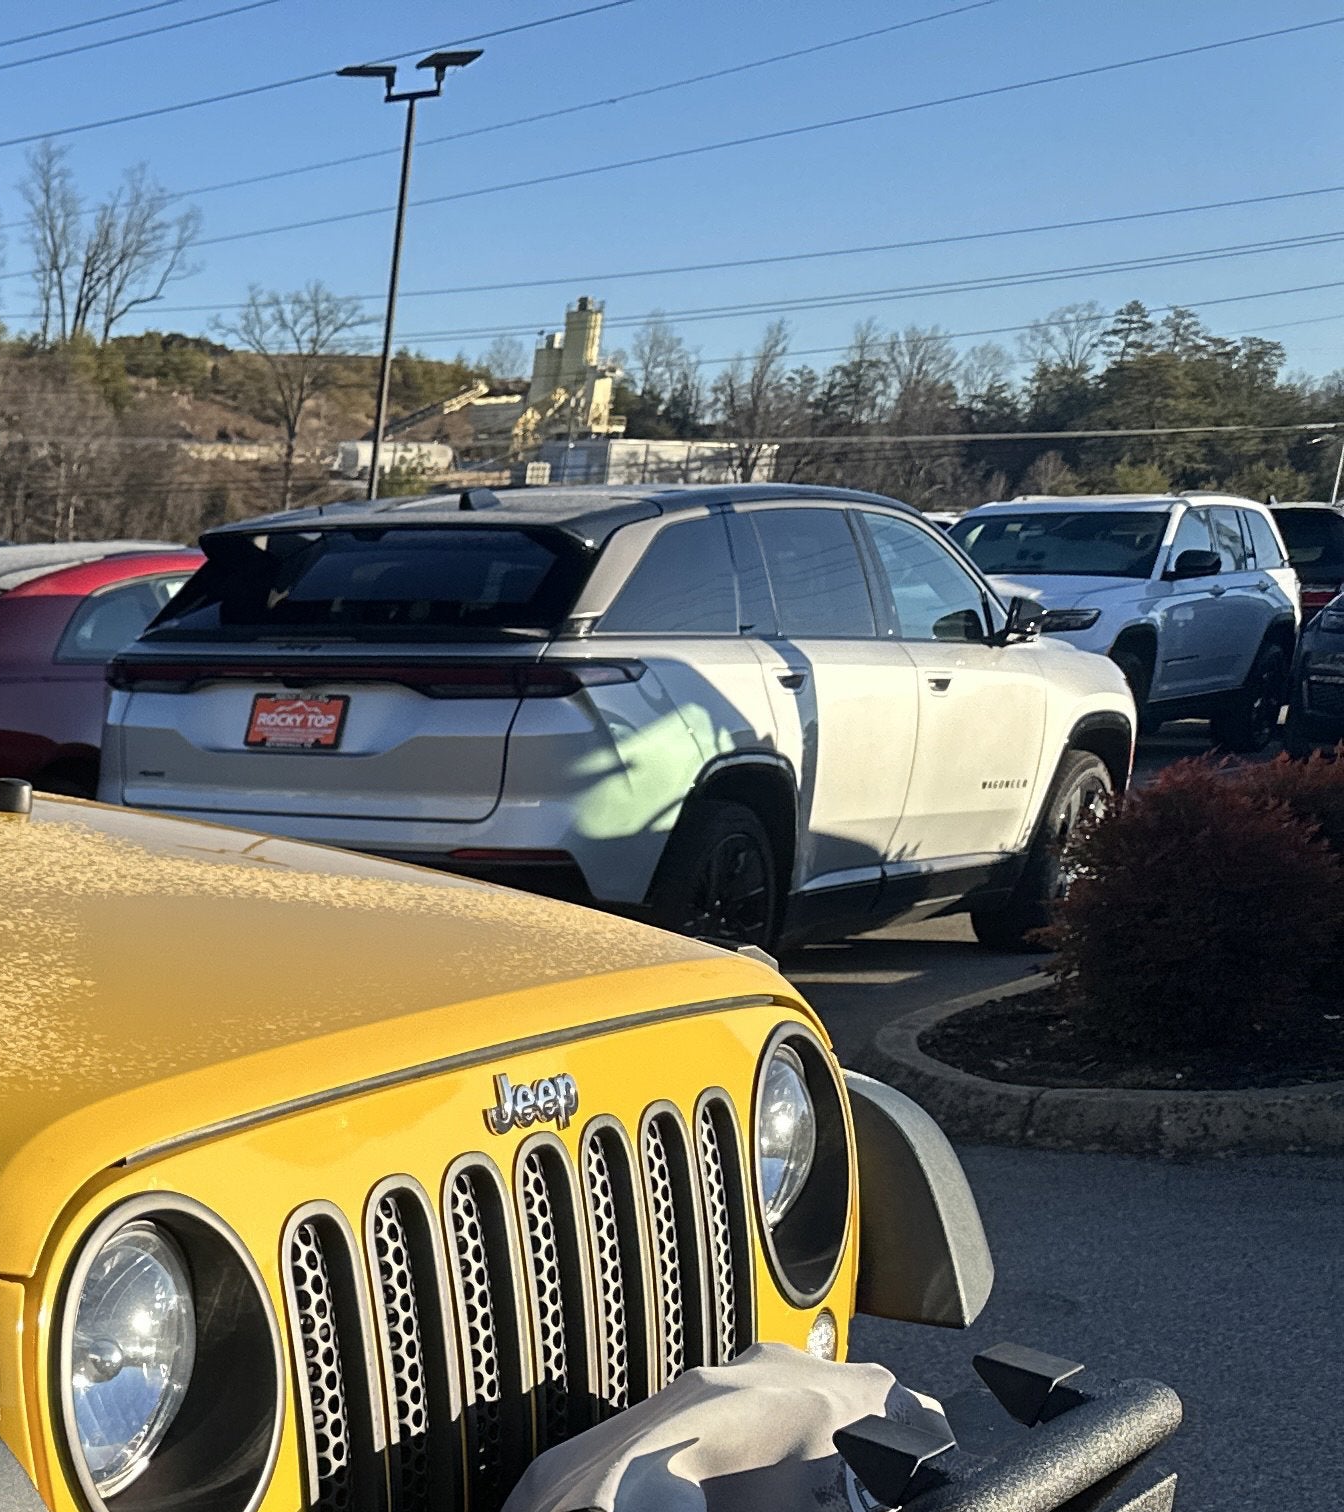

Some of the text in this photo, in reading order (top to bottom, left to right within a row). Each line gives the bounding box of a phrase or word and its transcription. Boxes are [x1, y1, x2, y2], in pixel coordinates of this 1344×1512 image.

[256, 711, 336, 728] ROCKY TOP
[482, 1072, 579, 1137] Jeep
